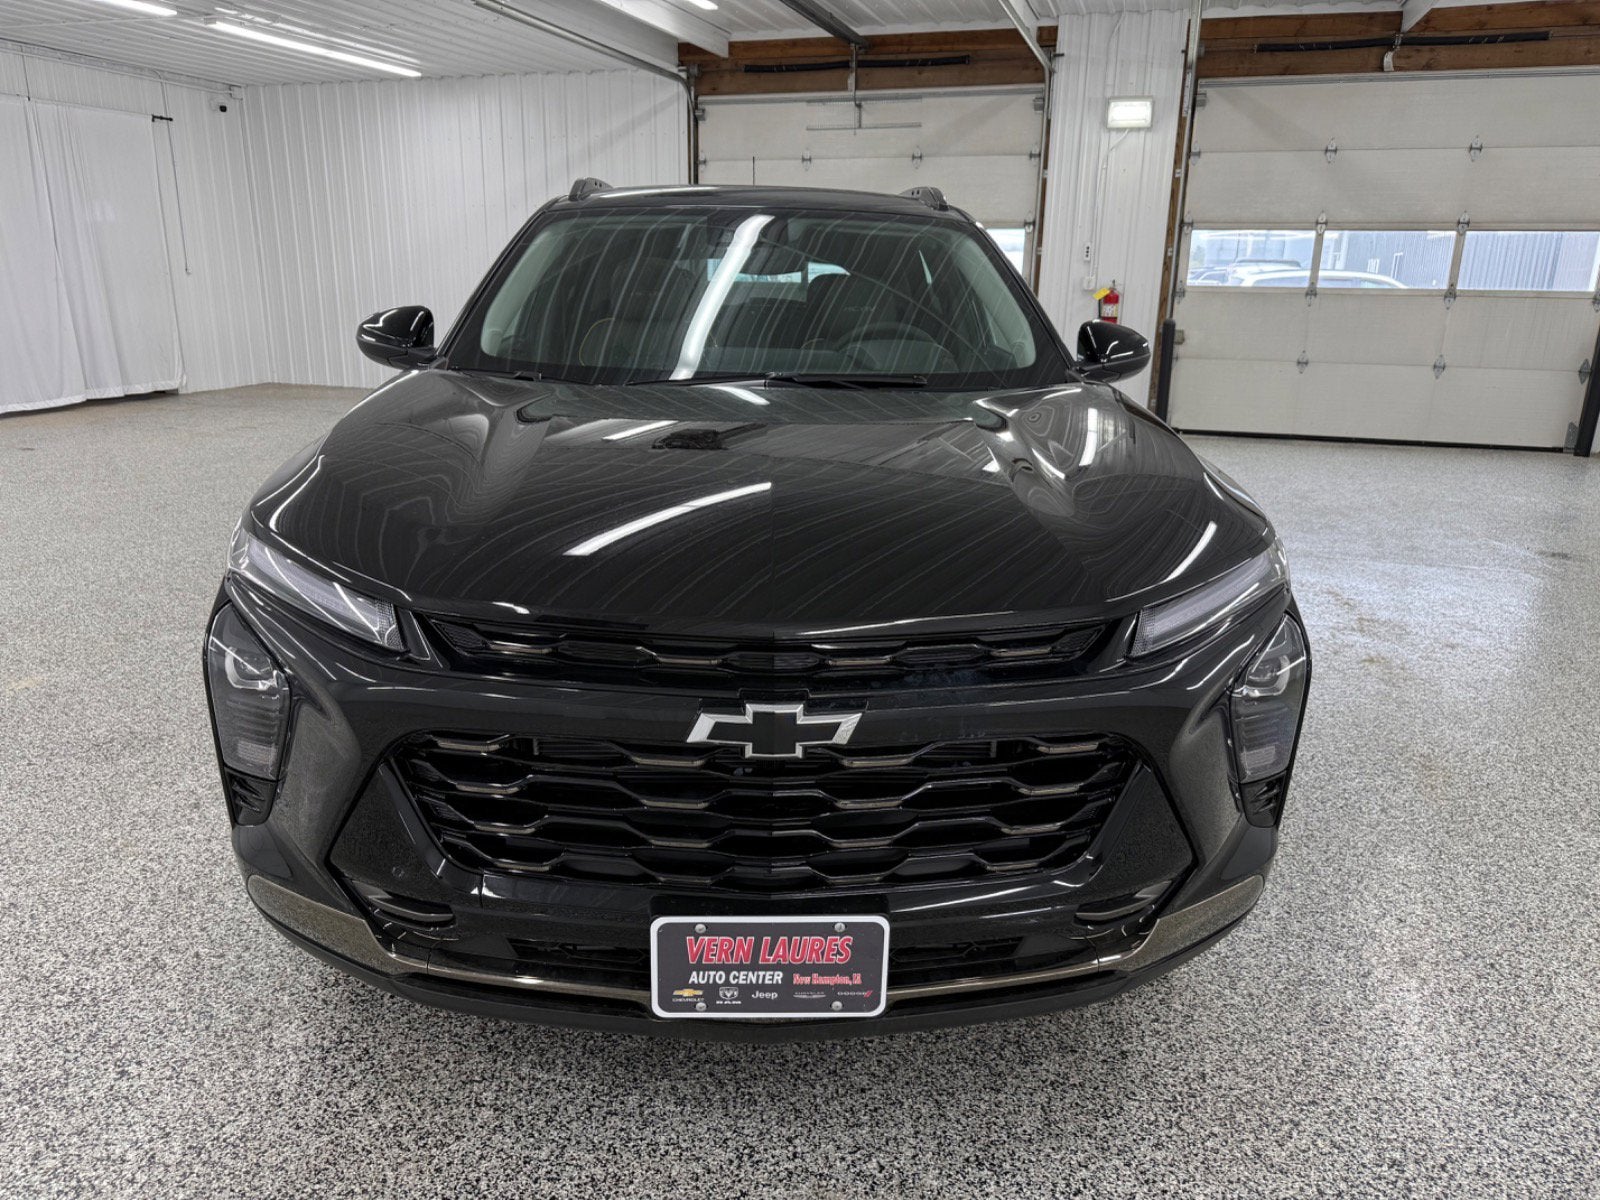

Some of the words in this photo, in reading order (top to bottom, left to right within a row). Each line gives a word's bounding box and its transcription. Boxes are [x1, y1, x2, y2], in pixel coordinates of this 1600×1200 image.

[686, 936, 755, 965] VERN
[758, 936, 853, 965] LAURES
[689, 971, 727, 985] AUTO
[729, 971, 783, 985] CENTER
[793, 973, 811, 985] New
[812, 973, 852, 986] Hampton,
[752, 990, 778, 1000] Jeep
